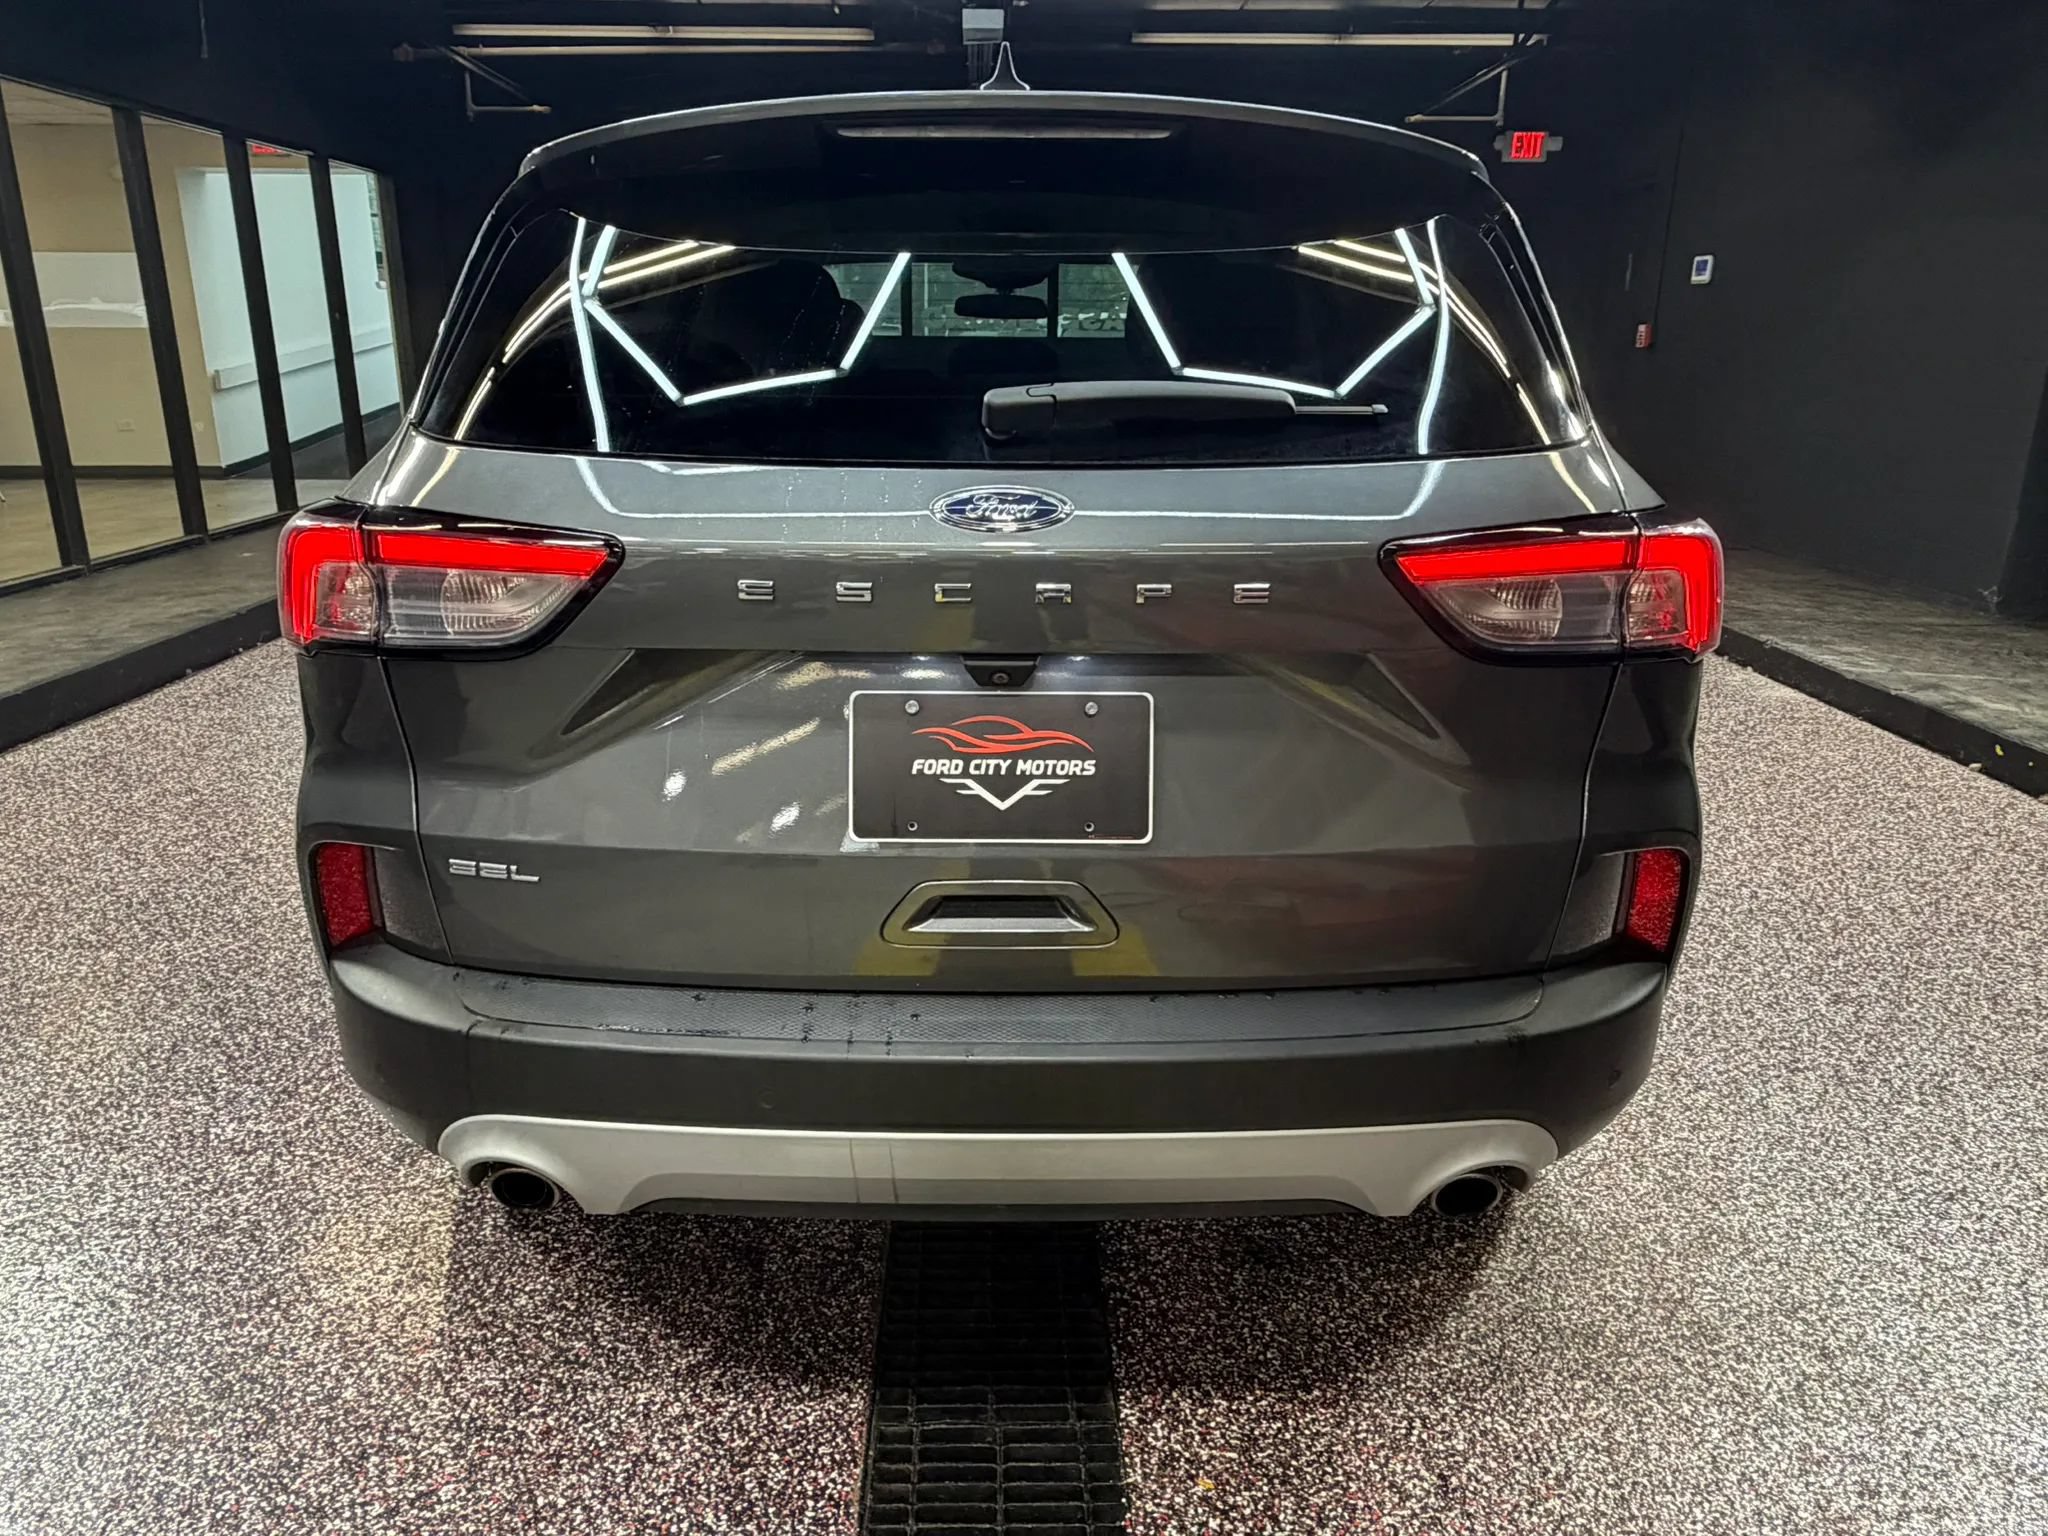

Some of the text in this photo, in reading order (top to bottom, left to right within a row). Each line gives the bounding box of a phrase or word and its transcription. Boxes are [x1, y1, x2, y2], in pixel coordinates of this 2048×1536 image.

[1511, 131, 1545, 159] EXIT
[965, 493, 1039, 520] Ford
[737, 579, 1271, 604] ESCAPE
[911, 759, 1097, 776] FORD CITY MOTORS
